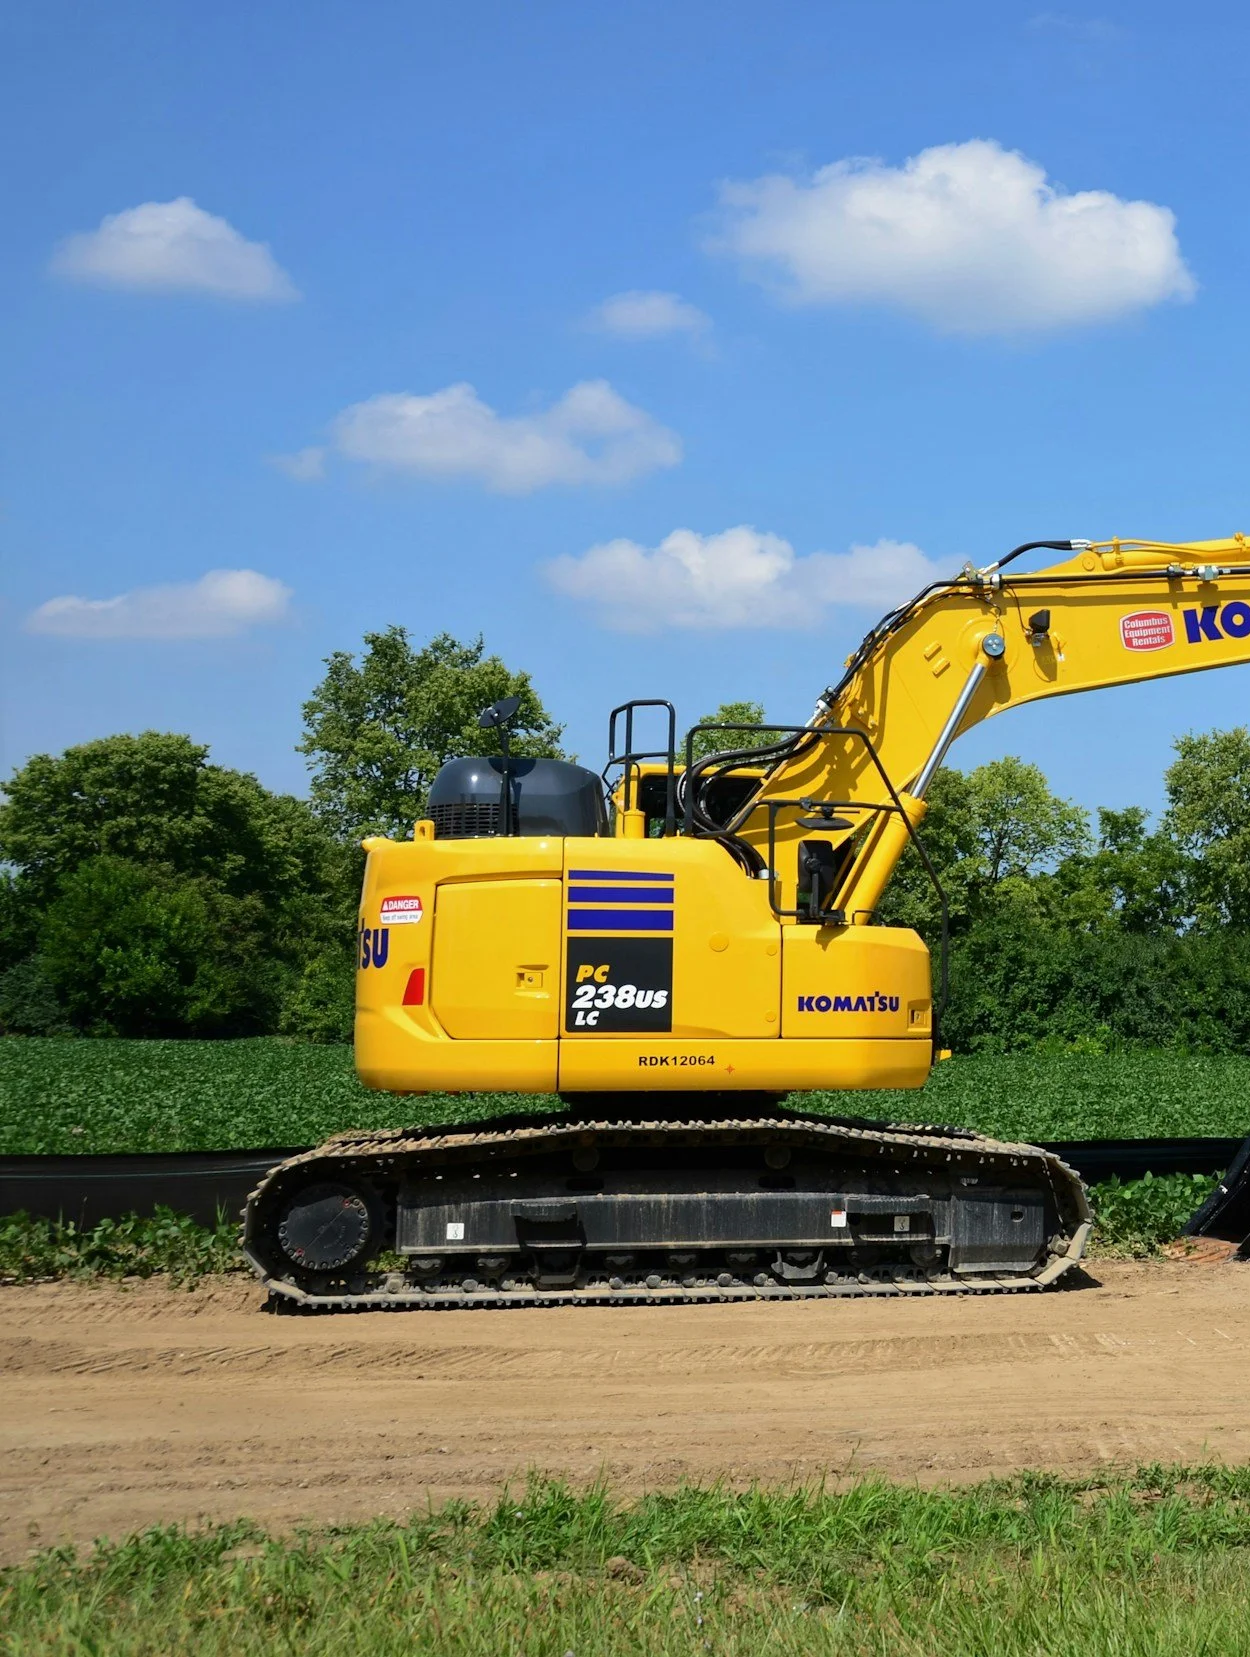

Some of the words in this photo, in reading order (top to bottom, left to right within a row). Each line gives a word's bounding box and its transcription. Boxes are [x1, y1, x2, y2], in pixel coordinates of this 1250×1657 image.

[1124, 617, 1168, 628] Columbus
[1124, 626, 1171, 638] Equipment
[1132, 635, 1165, 646] Rentals
[388, 899, 419, 909] DANGER
[360, 918, 389, 969] SU
[575, 964, 610, 983] PC
[797, 991, 900, 1013] KOMATSU
[575, 1011, 600, 1026] LC
[638, 1055, 716, 1067] RDK12064
